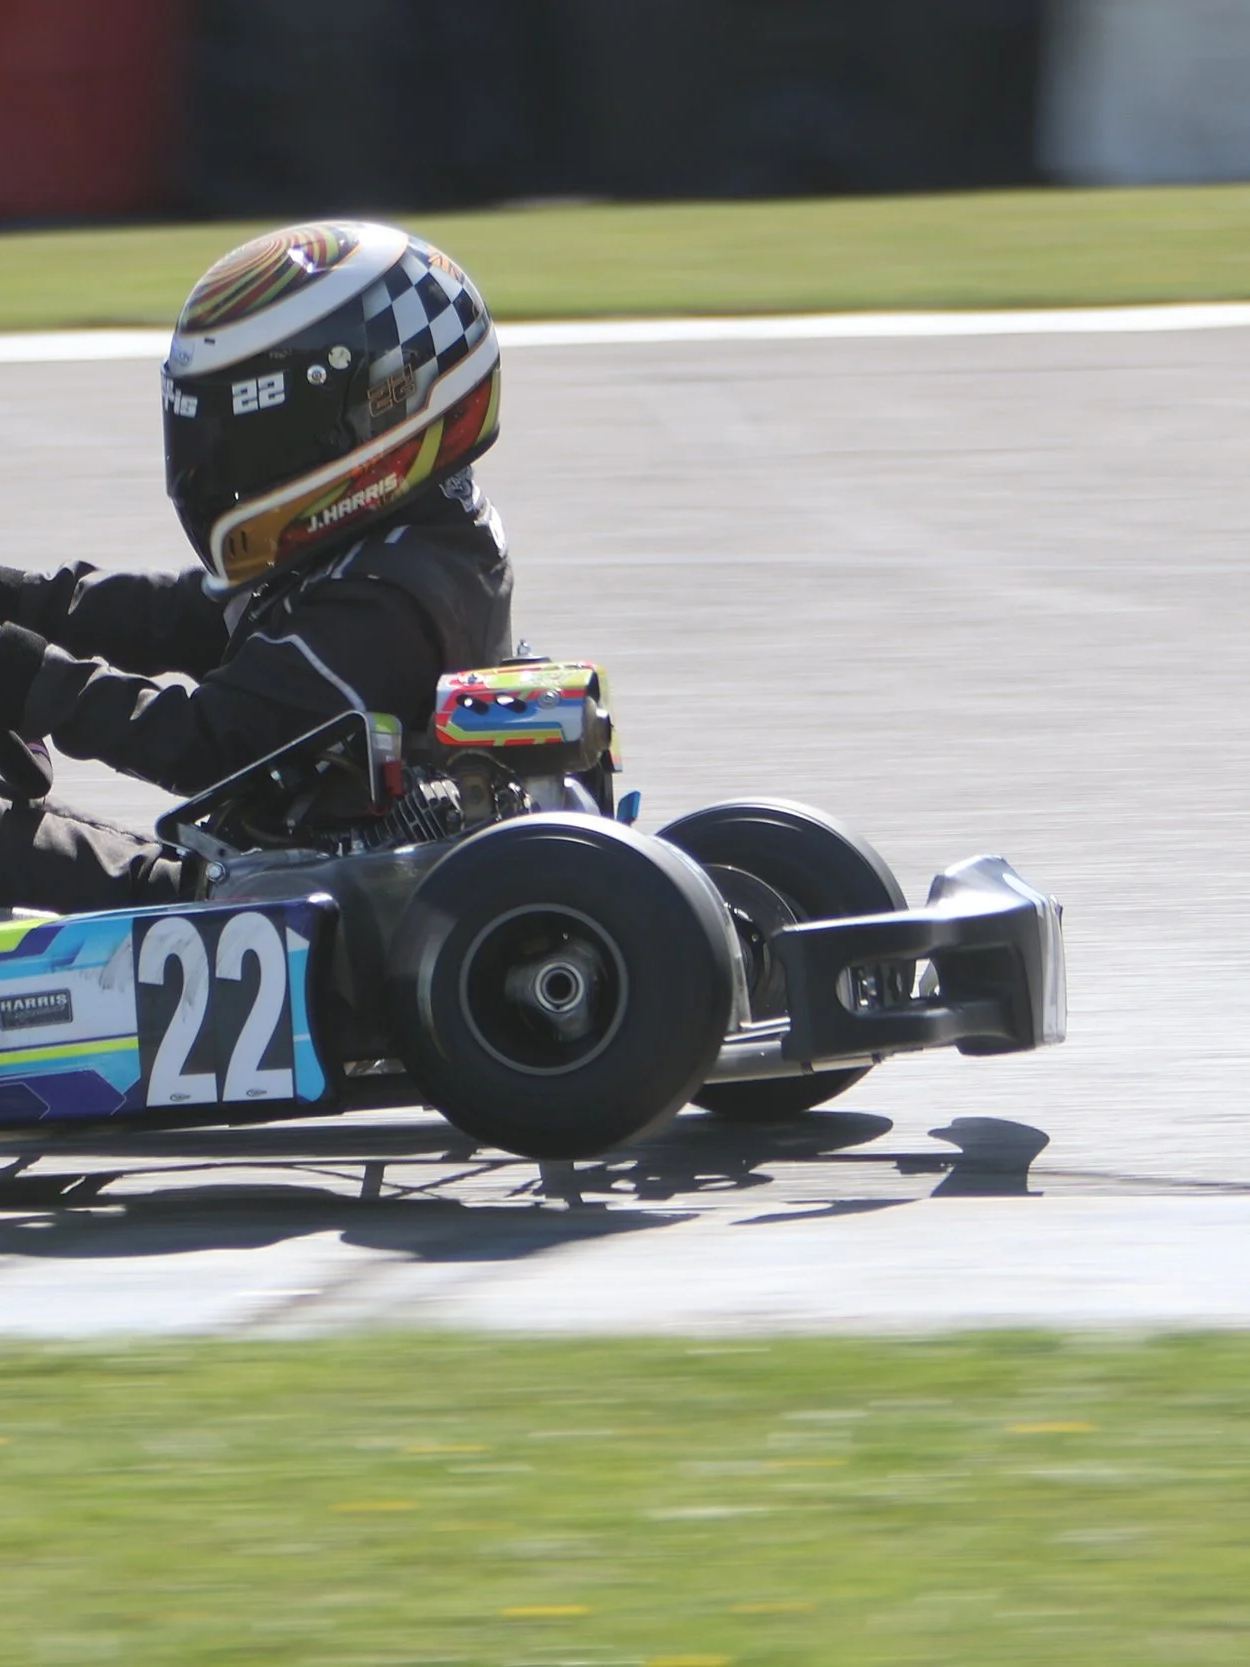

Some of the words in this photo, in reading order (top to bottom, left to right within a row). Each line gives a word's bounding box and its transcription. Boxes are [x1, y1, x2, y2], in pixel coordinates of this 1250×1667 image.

[232, 371, 285, 415] 22
[306, 472, 401, 533] J.HARRIS
[0, 993, 67, 1012] HARRIS
[138, 911, 294, 1107] 22
